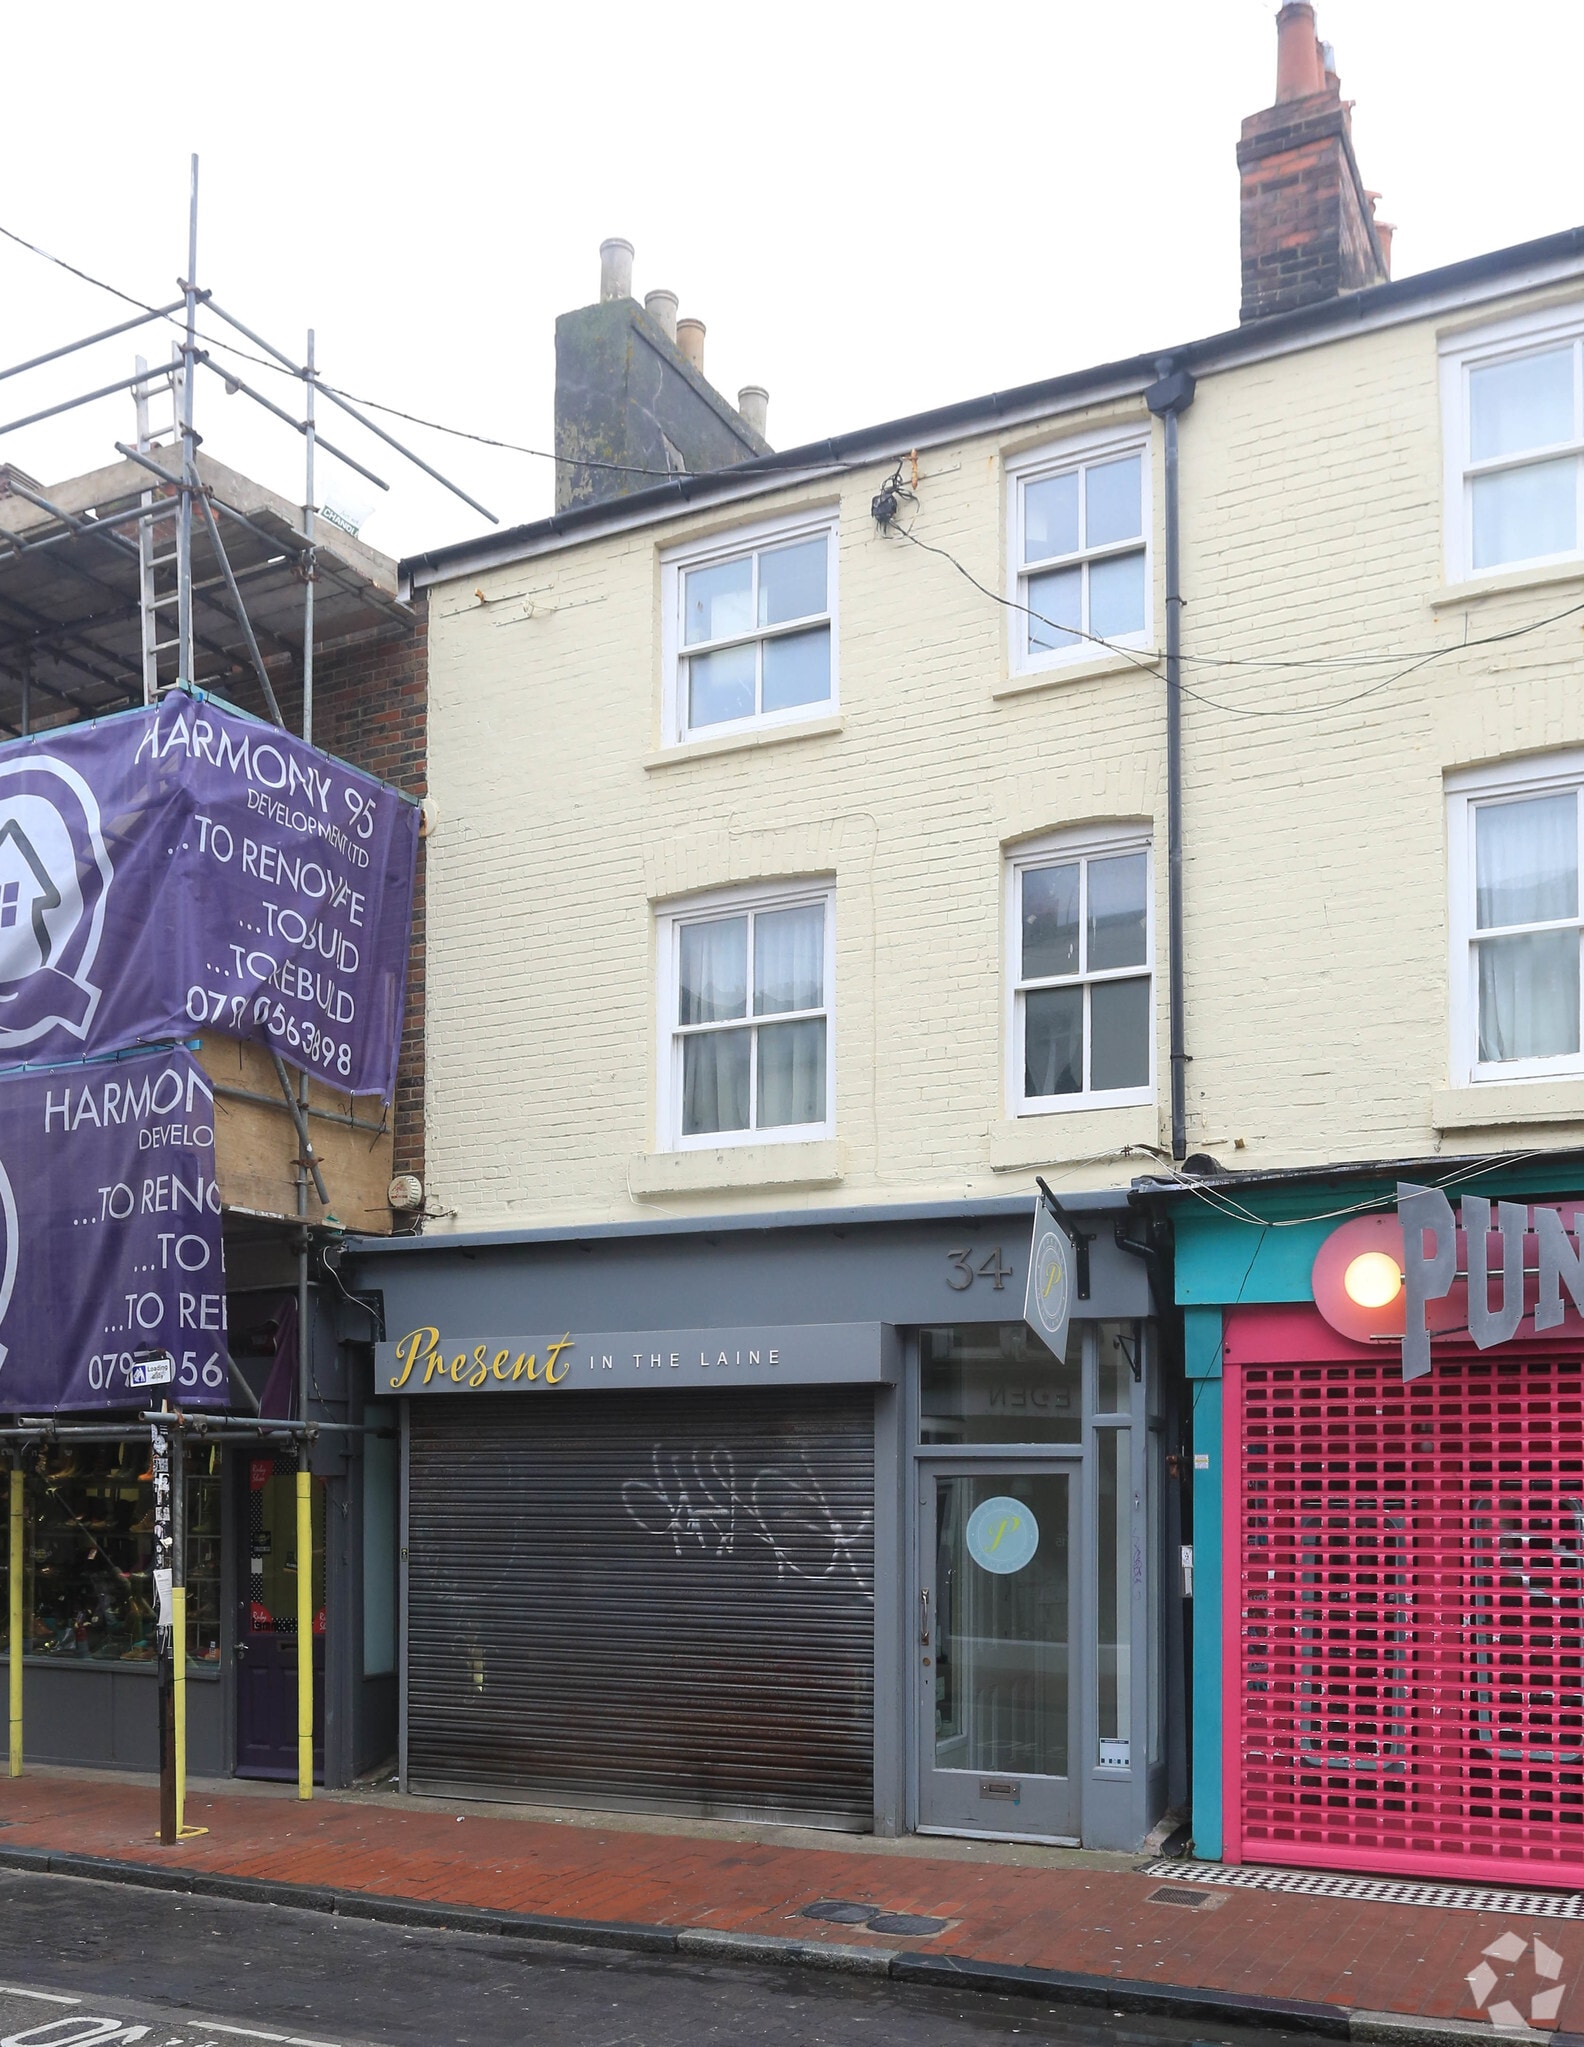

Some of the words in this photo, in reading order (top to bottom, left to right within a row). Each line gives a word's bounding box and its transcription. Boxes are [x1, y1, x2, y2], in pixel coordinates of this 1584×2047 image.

[134, 712, 332, 813] HARMONY
[344, 787, 377, 839] 95
[247, 788, 349, 855] DEVELOPMENT
[347, 841, 370, 868] LTD
[139, 1124, 215, 1150] DEVELO
[945, 1247, 1014, 1291] 34
[390, 1325, 576, 1388] Present
[589, 1355, 613, 1370] IN
[633, 1352, 680, 1369] THE
[700, 1349, 780, 1367] LAINE
